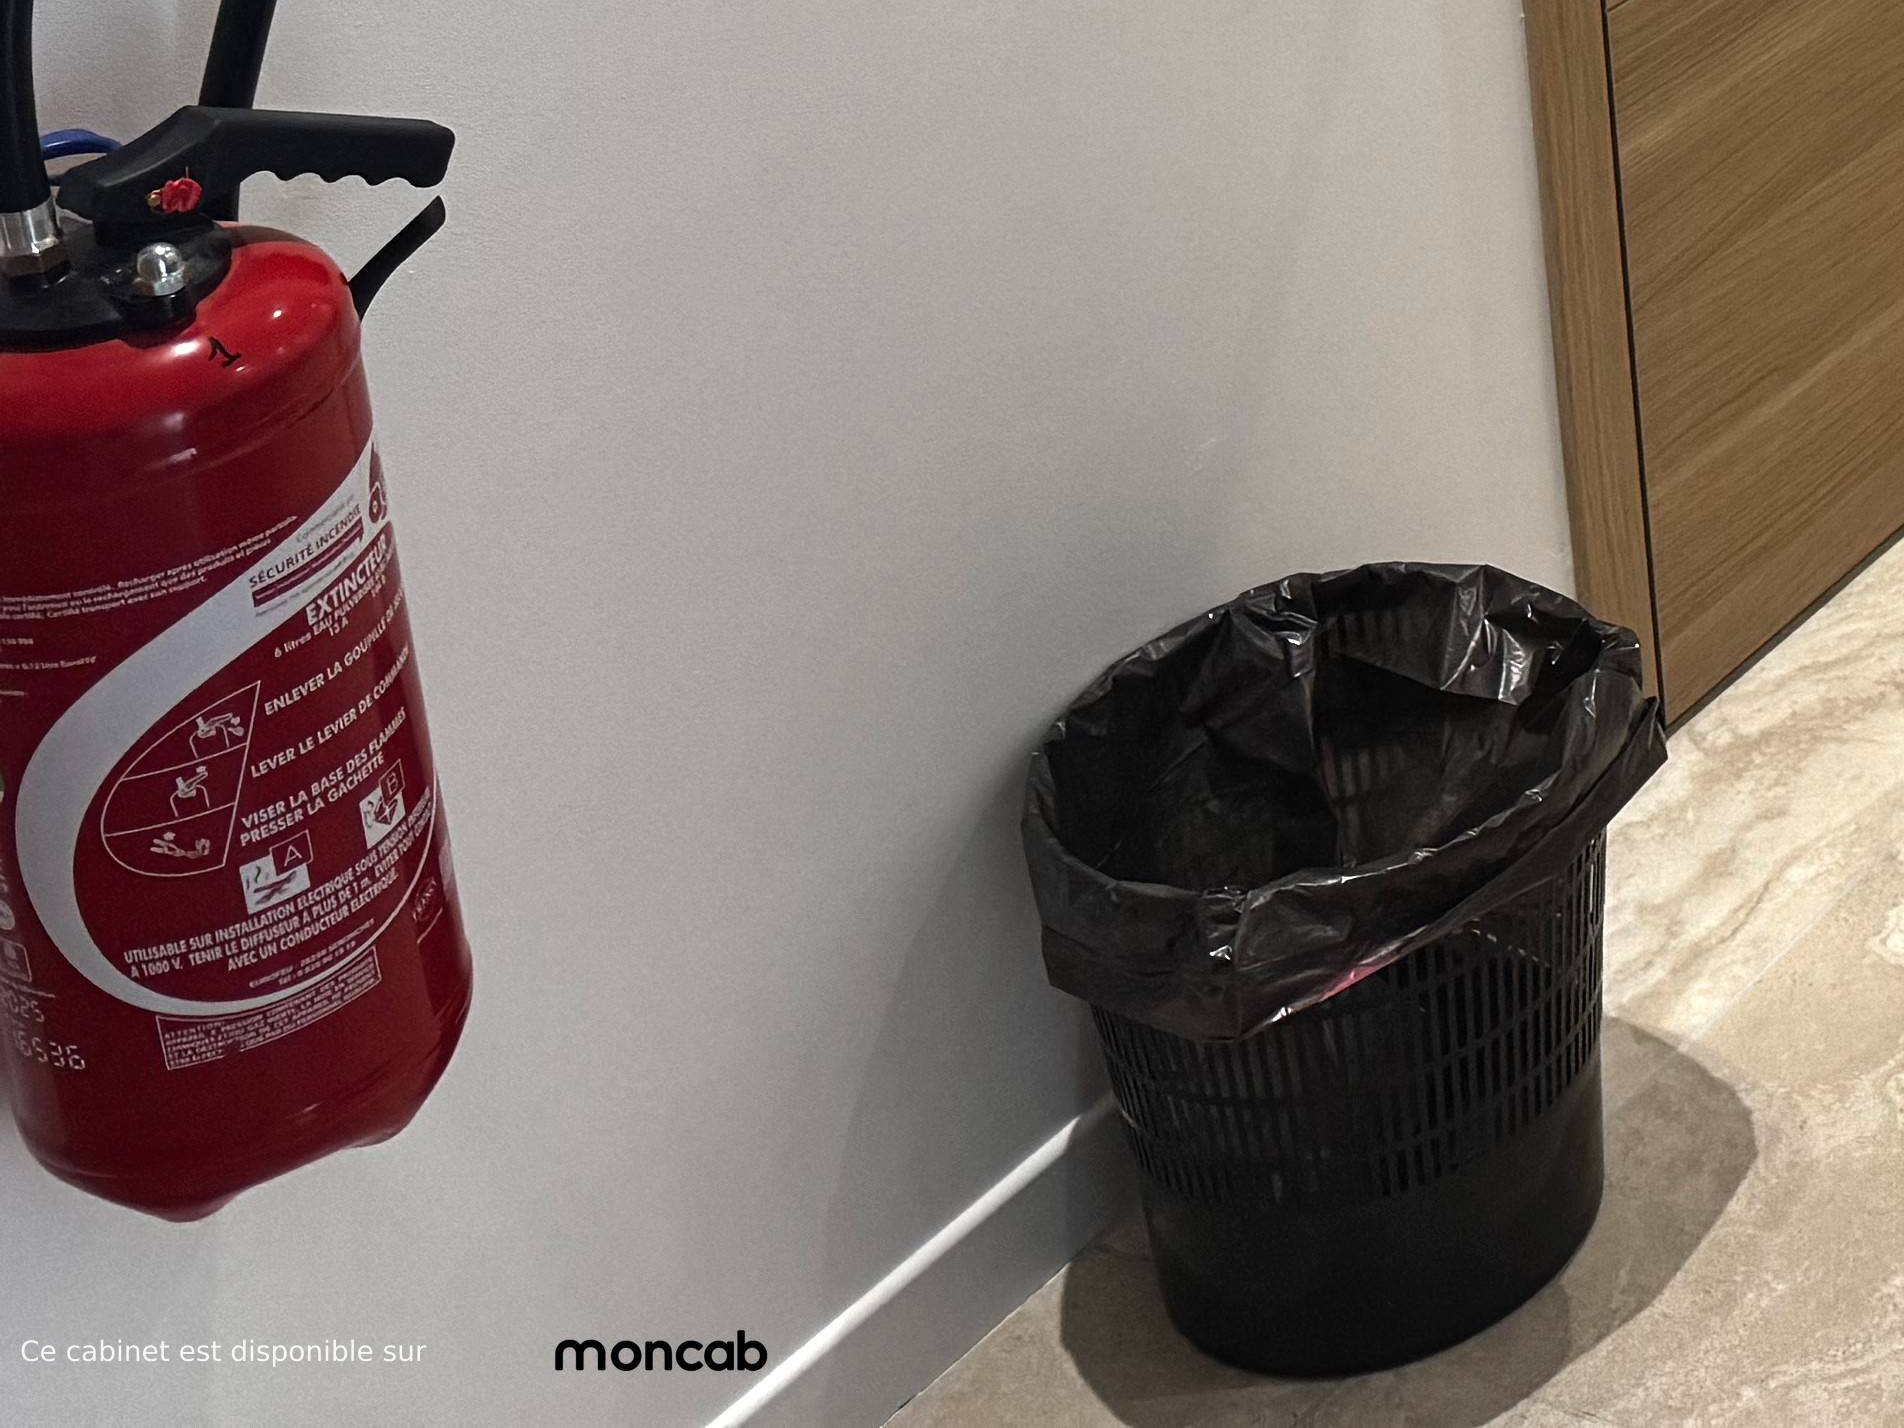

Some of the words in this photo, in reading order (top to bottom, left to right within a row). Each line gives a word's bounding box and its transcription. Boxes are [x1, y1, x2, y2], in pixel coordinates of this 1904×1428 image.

[305, 534, 387, 626] EXTINCTEUR
[264, 673, 325, 716] ENLEVER
[326, 661, 343, 681] LA
[343, 619, 387, 666] GOUPILLE
[251, 748, 296, 778] LEVER
[298, 737, 315, 755] LE
[317, 708, 357, 744] LEVIER
[358, 695, 373, 715] DE
[240, 808, 305, 847] PRESSER
[307, 799, 326, 816] LA
[327, 751, 385, 803] GACHETTE
[241, 801, 286, 829] VISER
[289, 790, 309, 808] LA
[310, 767, 345, 796] BASE
[346, 750, 368, 774] DES
[386, 771, 400, 795] B
[284, 844, 302, 867] A
[123, 939, 188, 963] UTILISABLE
[189, 932, 213, 950] SUR
[215, 906, 296, 941] INSTALLATION
[188, 948, 223, 966] TENIR
[225, 941, 238, 956] LE
[241, 917, 301, 946] DIFFUSEUR
[227, 951, 258, 972] AVEC
[259, 944, 278, 960] UN
[280, 909, 350, 950] CONDUCTEUR
